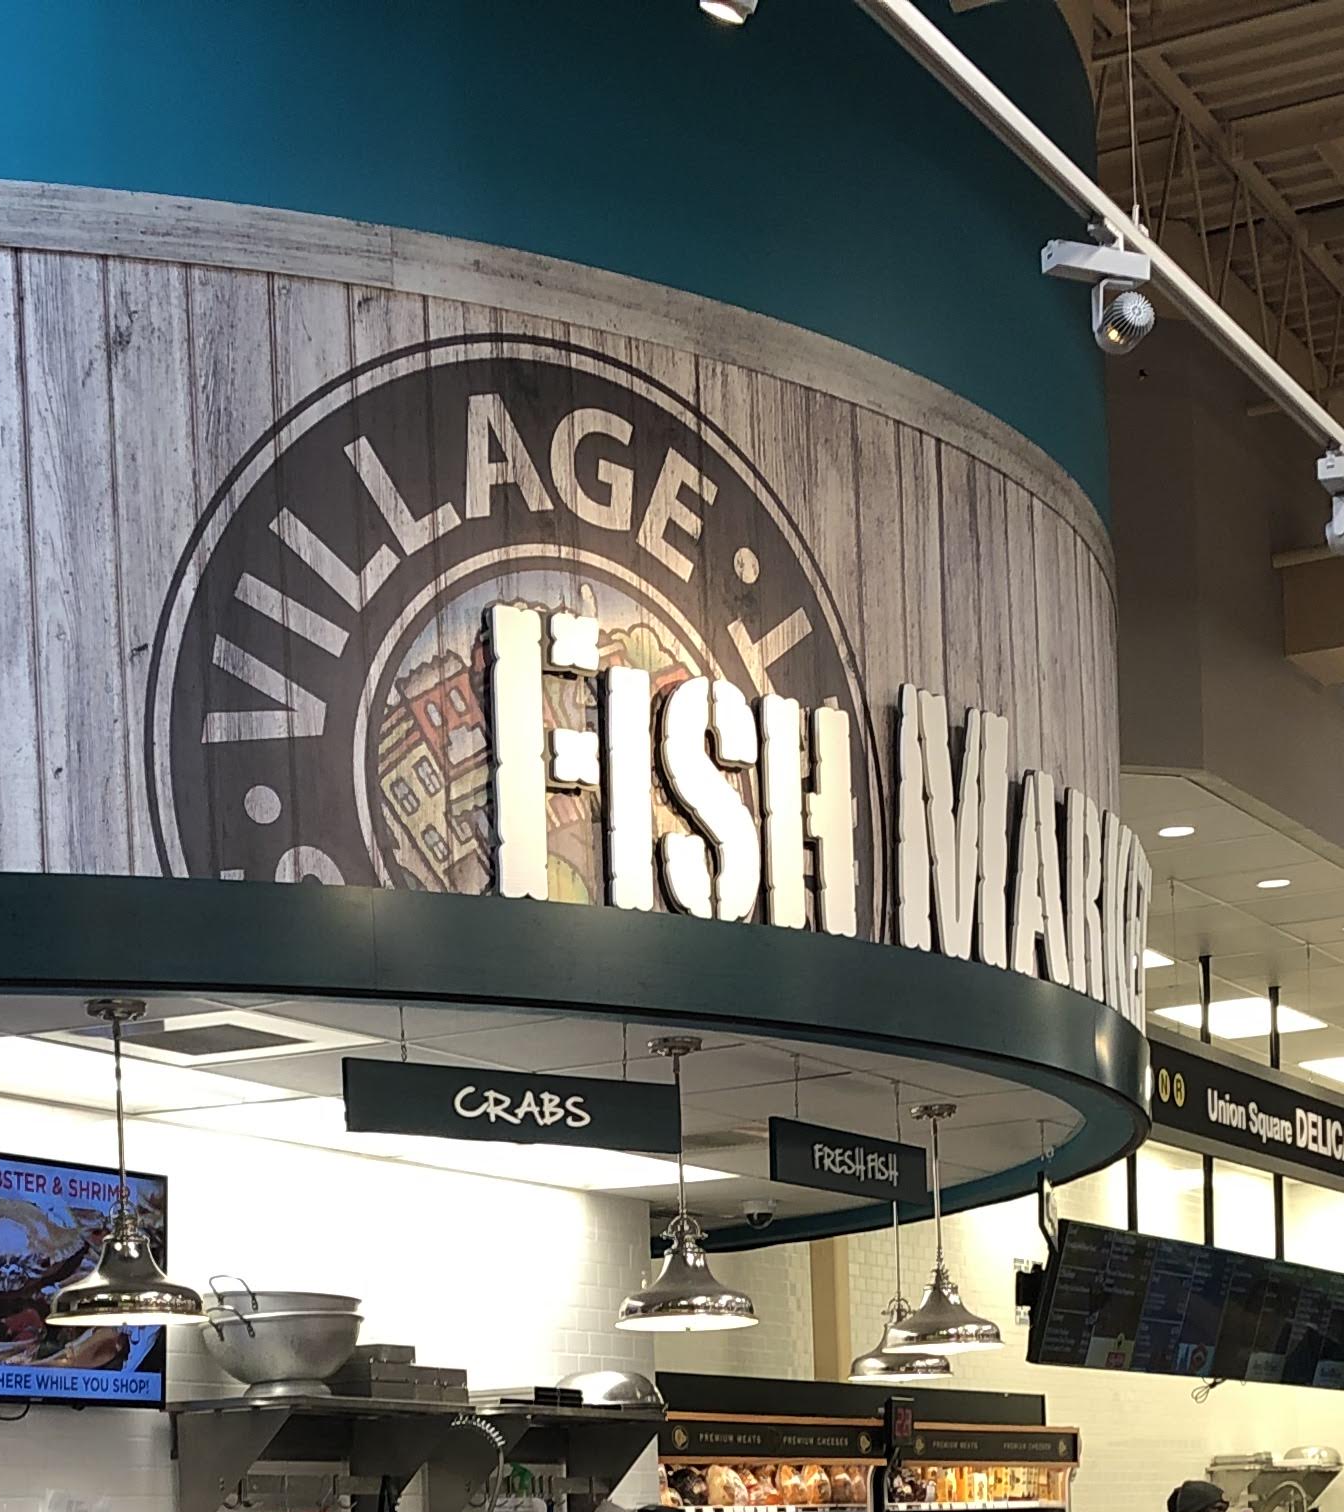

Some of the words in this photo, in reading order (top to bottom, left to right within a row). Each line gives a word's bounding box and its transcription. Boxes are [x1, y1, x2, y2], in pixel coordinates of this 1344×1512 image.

[202, 393, 718, 744] VILLAGE
[486, 601, 857, 938] FISH
[453, 1085, 591, 1128] CRABS
[1207, 1088, 1246, 1131] Union
[1248, 1101, 1293, 1144] Square
[52, 1176, 63, 1196] &
[813, 1143, 865, 1182] FRESH
[866, 1152, 899, 1186] FISH
[36, 1375, 78, 1391] WHILE
[82, 1377, 108, 1392] YOU
[113, 1378, 149, 1394] SHOP!
[699, 1432, 734, 1443] PREMIUM
[737, 1434, 761, 1444] MEATS
